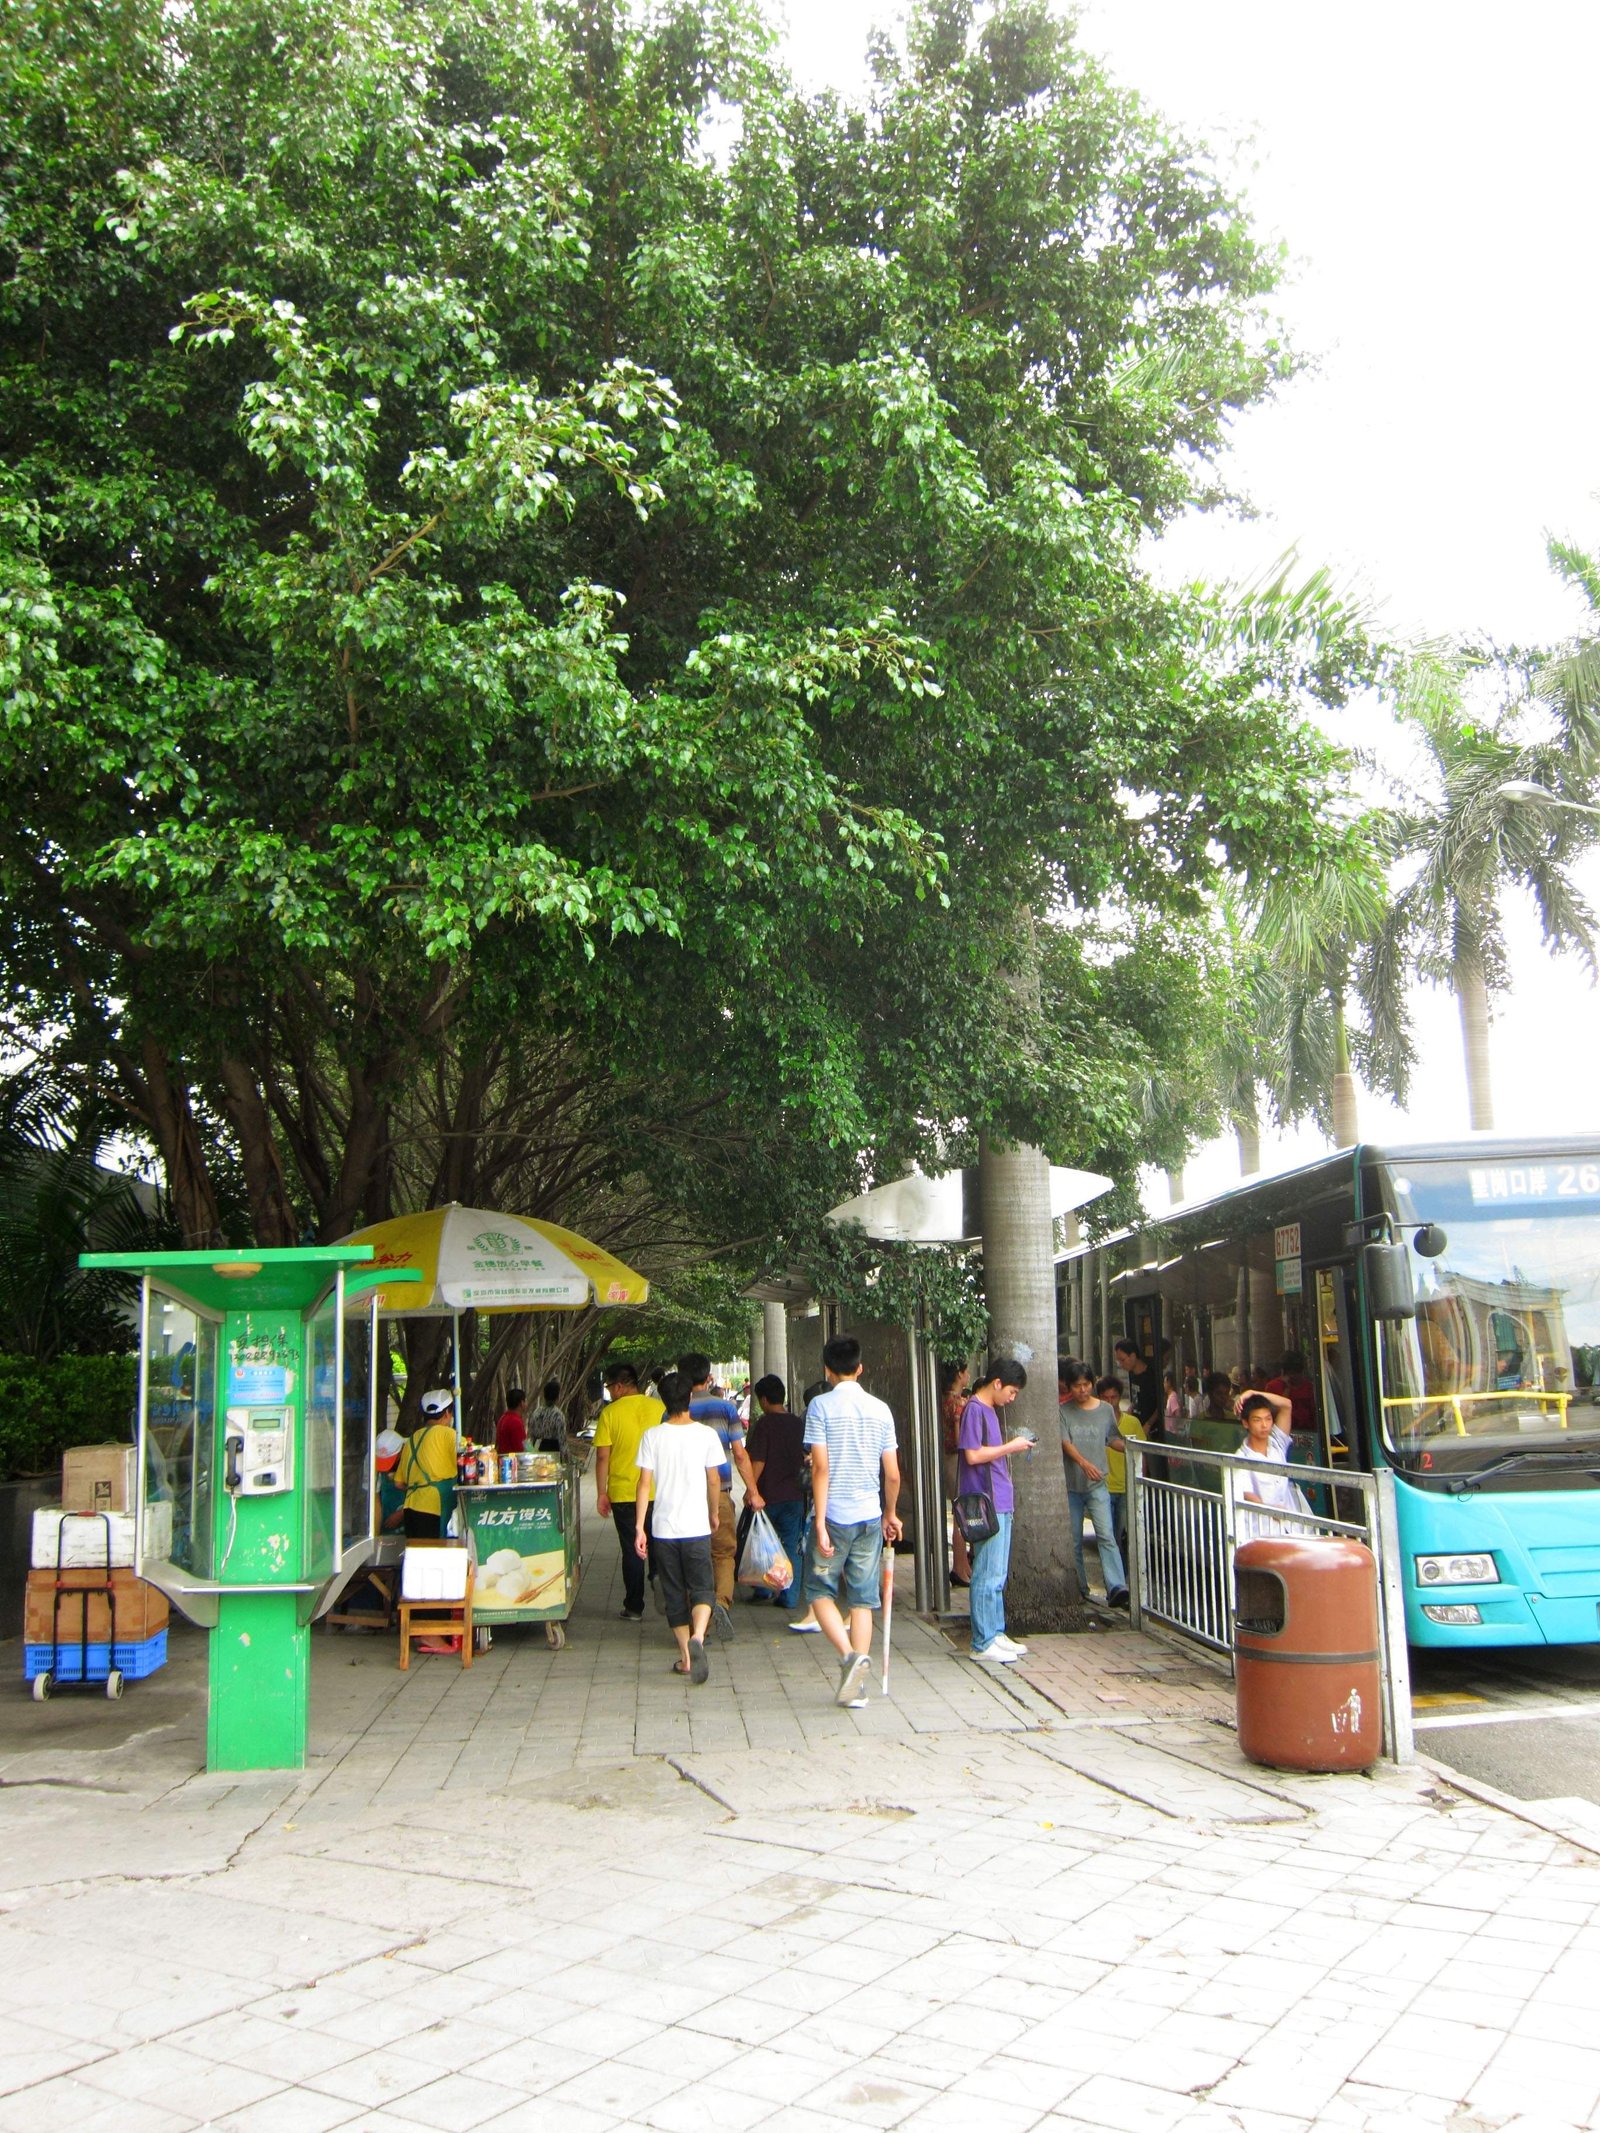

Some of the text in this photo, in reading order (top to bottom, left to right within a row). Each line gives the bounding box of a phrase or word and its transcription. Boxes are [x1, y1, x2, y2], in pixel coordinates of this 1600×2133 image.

[1422, 1453, 1433, 1469] 2
[477, 1507, 552, 1526] 北方馒头
